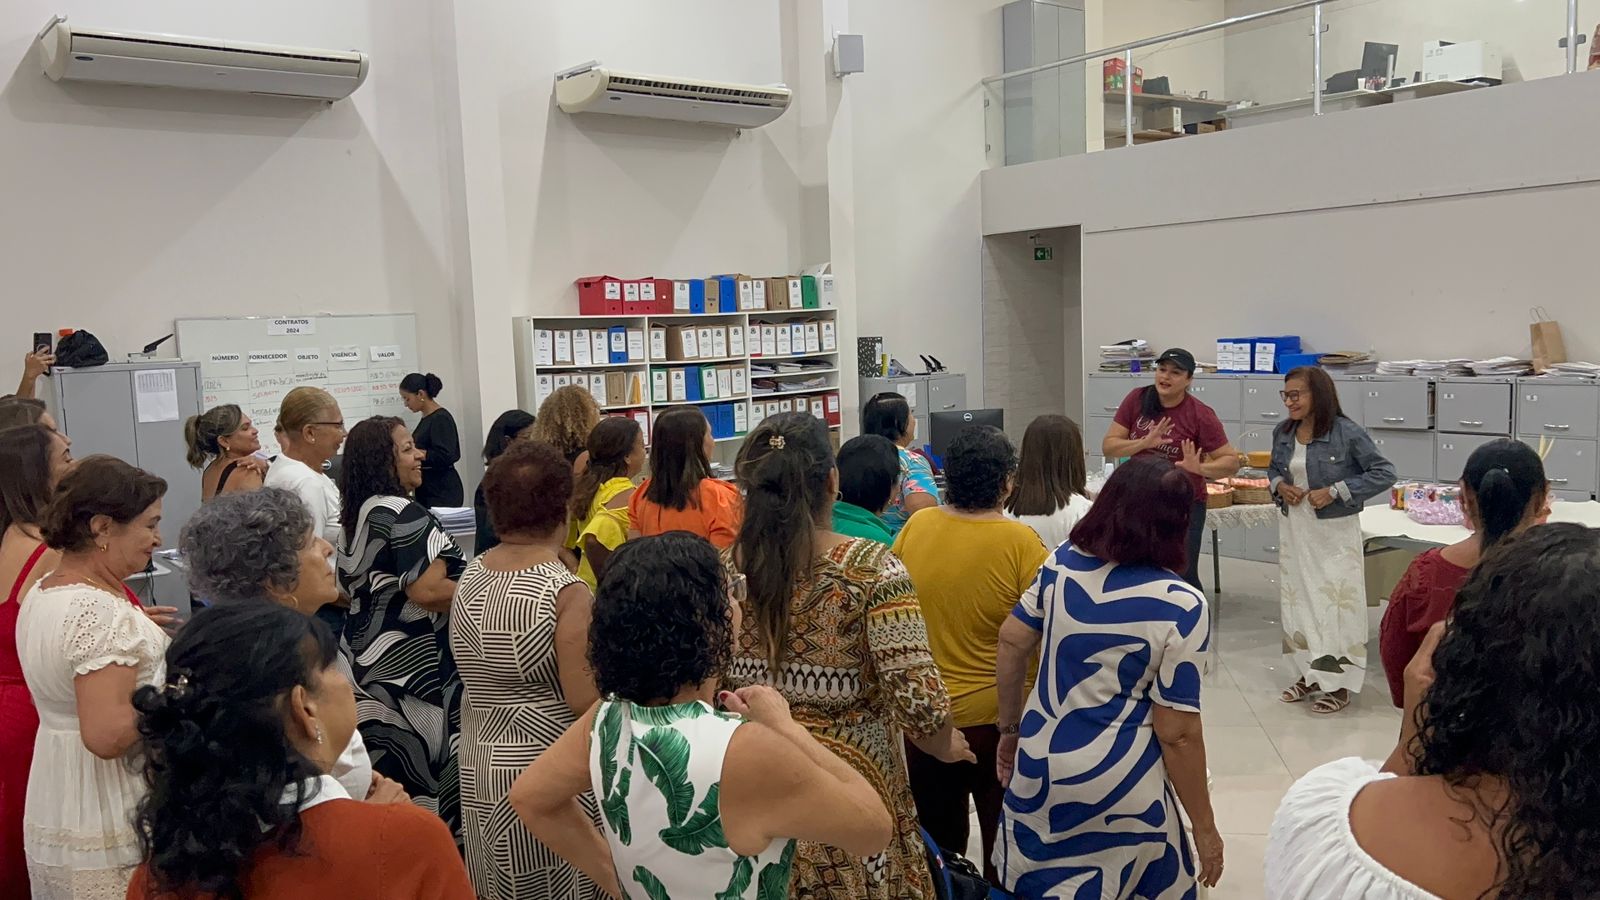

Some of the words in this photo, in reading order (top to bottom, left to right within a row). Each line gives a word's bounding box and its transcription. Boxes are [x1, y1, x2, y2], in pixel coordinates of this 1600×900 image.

[211, 353, 240, 362] NÚMERO
[249, 353, 288, 361] FORNECEDOR
[330, 350, 358, 359] VIGÊNCIA
[377, 351, 395, 359] VALOR
